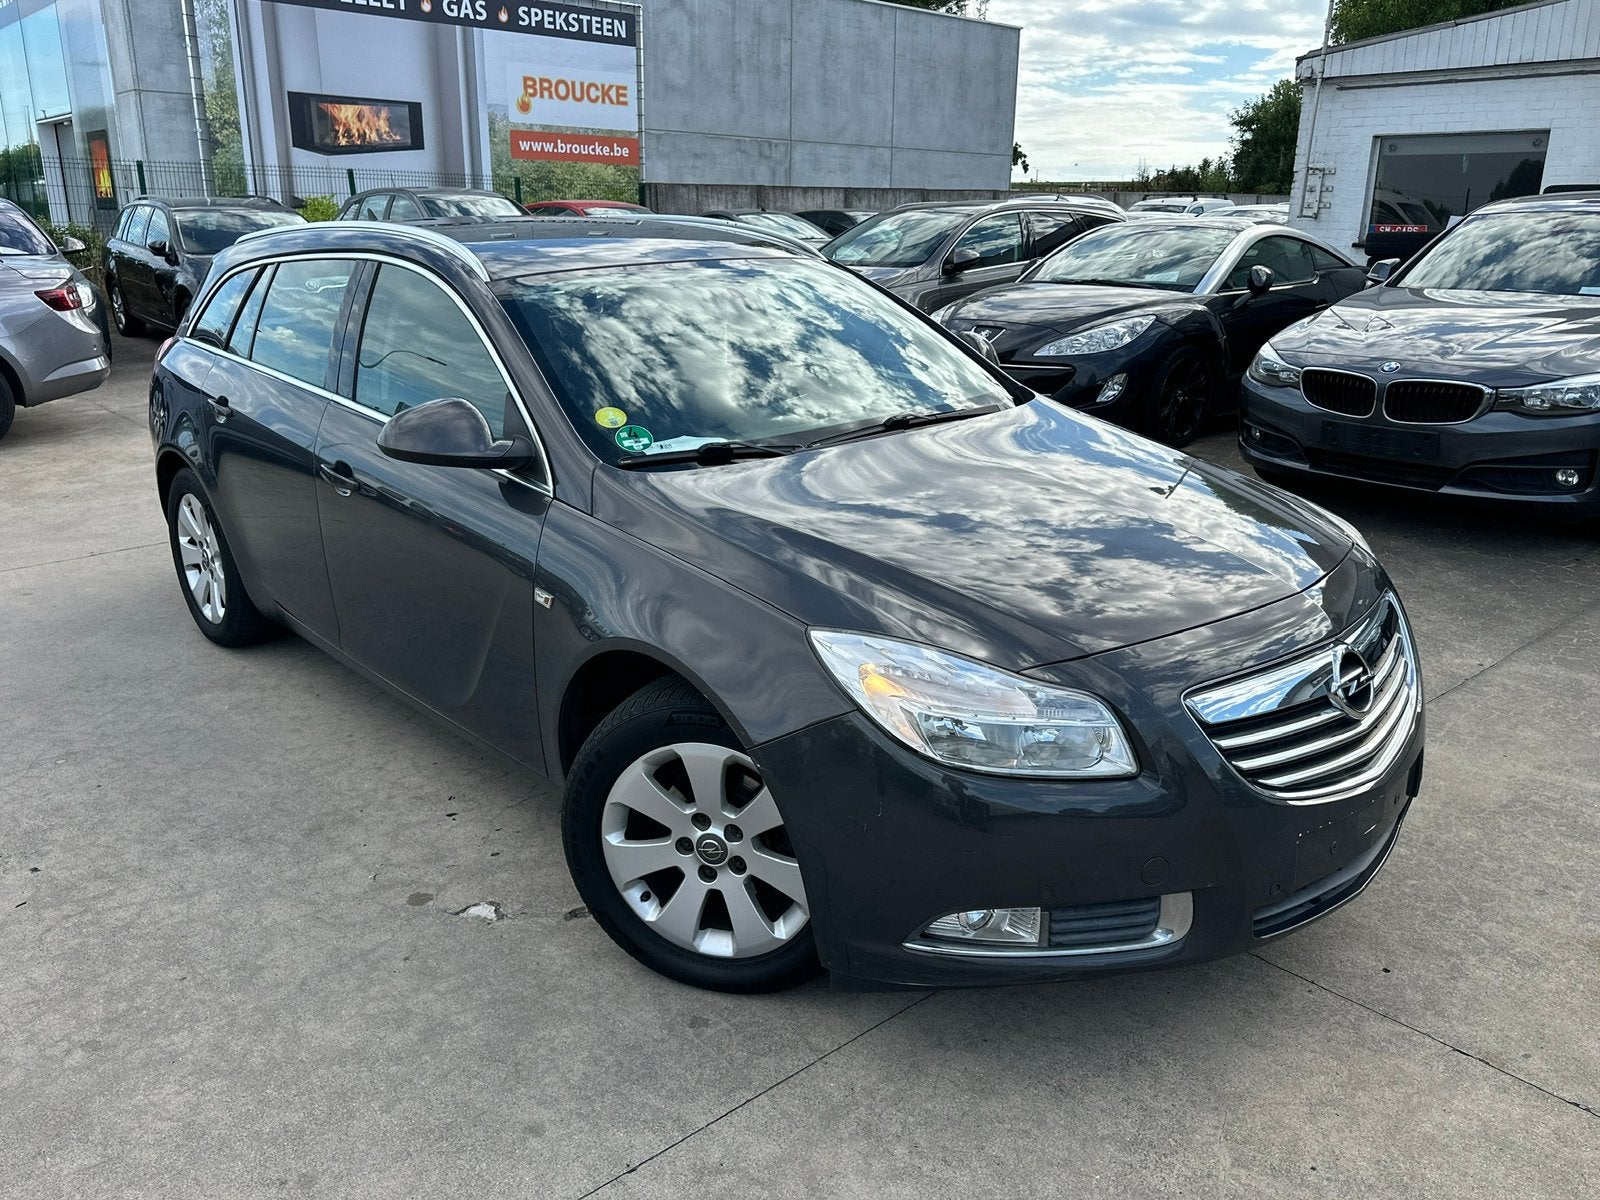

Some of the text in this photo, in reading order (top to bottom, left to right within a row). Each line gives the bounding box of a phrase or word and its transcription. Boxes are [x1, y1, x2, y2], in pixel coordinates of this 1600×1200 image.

[442, 0, 627, 38] GAS SPEKSTEEN
[522, 75, 629, 106] BROUCKE
[519, 139, 630, 157] www.broucke.be
